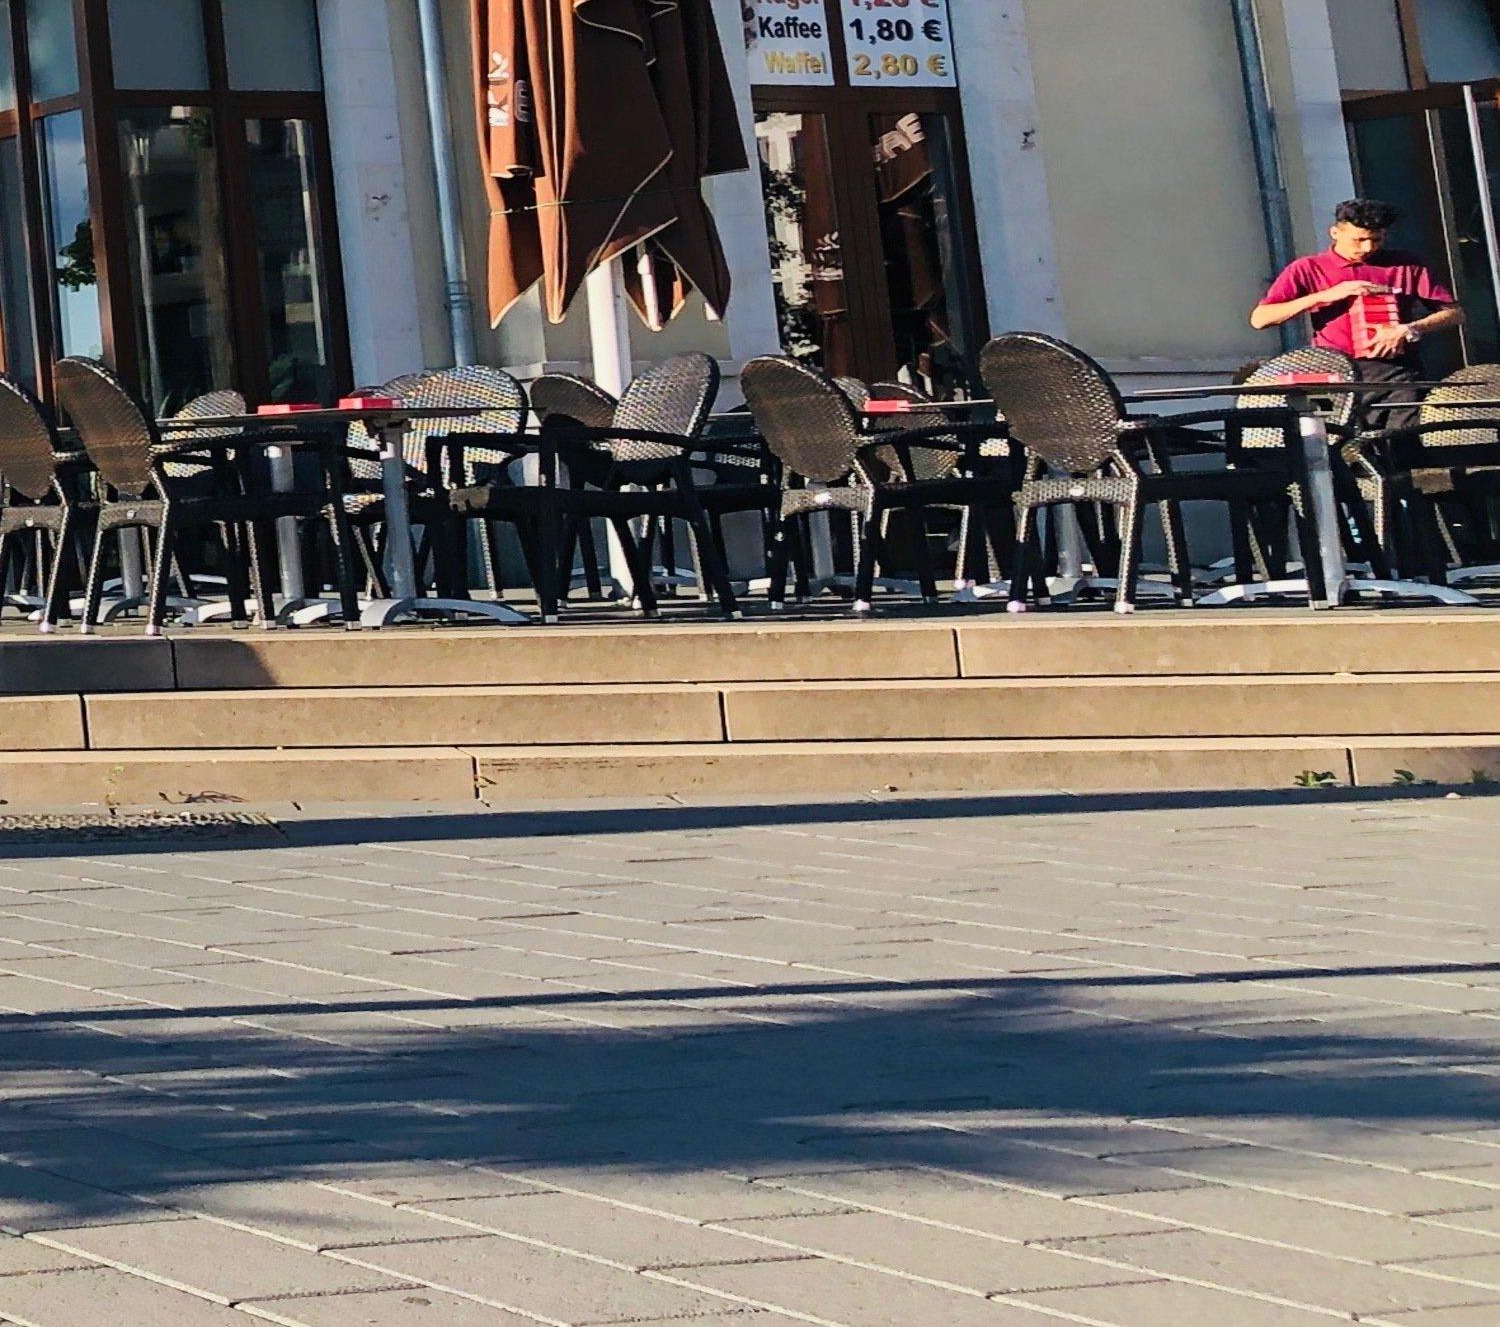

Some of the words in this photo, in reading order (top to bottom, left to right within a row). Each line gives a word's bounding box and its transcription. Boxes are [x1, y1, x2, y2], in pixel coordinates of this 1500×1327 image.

[758, 16, 823, 39] Kaffee
[849, 19, 914, 45] 1,80
[921, 19, 943, 42] €
[764, 49, 828, 74] Waffel
[853, 53, 919, 79] 2,80
[926, 54, 948, 77] €
